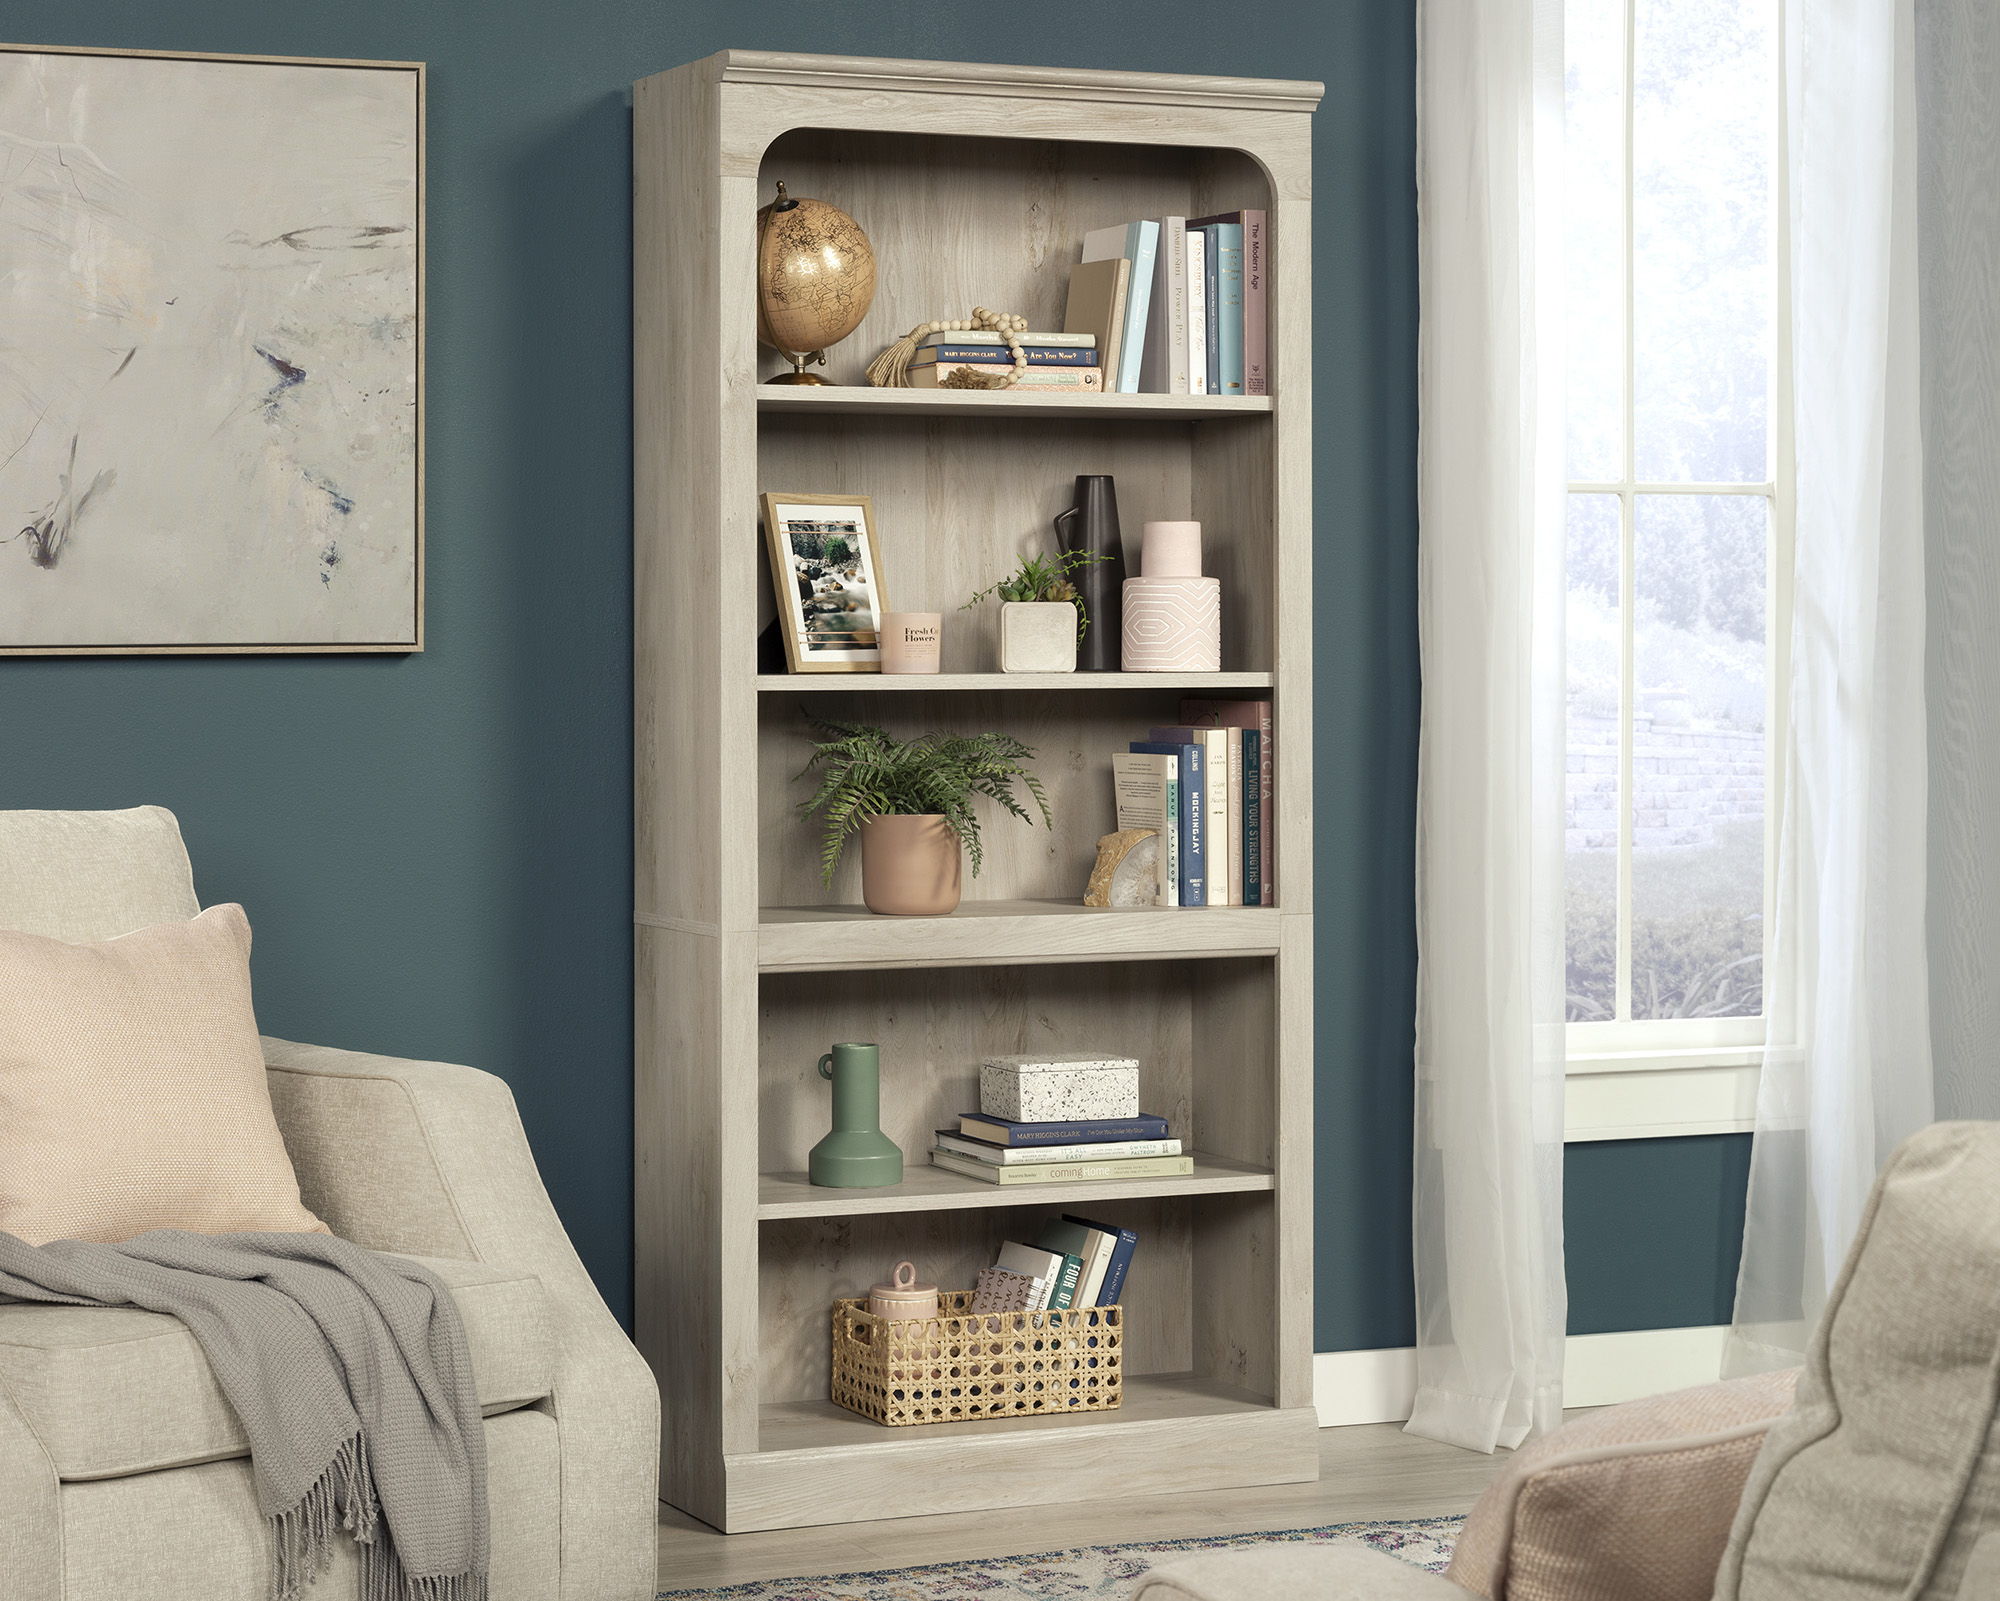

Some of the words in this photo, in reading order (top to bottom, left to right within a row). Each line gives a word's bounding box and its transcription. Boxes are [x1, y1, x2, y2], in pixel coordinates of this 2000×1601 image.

[1250, 274, 1259, 290] Age
[1262, 718, 1271, 799] MATCHA
[1249, 770, 1258, 799] LIVING
[1249, 803, 1258, 828] YOUR
[1250, 830, 1259, 883] STRENGTHS
[1063, 1263, 1081, 1288] FOUR
[1058, 1292, 1071, 1306] OF
